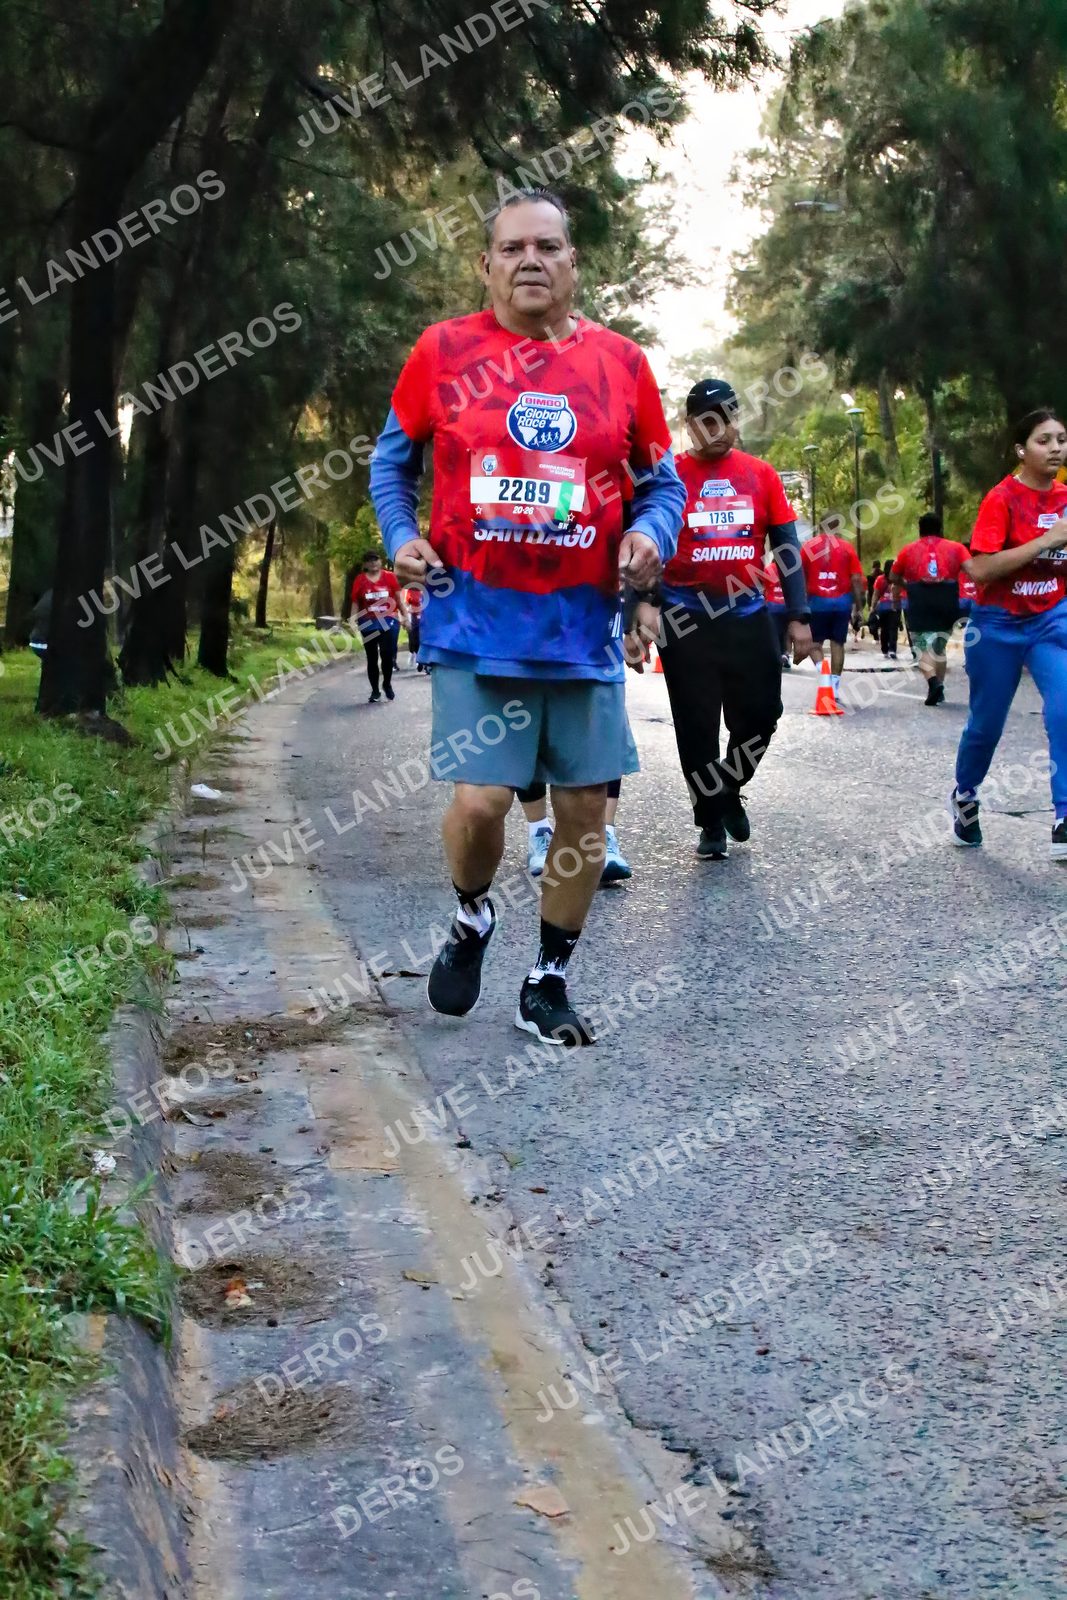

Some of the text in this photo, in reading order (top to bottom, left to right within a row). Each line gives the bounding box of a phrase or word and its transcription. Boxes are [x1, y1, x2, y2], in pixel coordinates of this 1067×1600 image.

[524, 397, 562, 407] BIMBO
[525, 407, 561, 421] Global
[517, 415, 546, 428] Race
[499, 478, 551, 504] 2289
[709, 511, 735, 524] 1736
[691, 545, 755, 562] SANTIAGO
